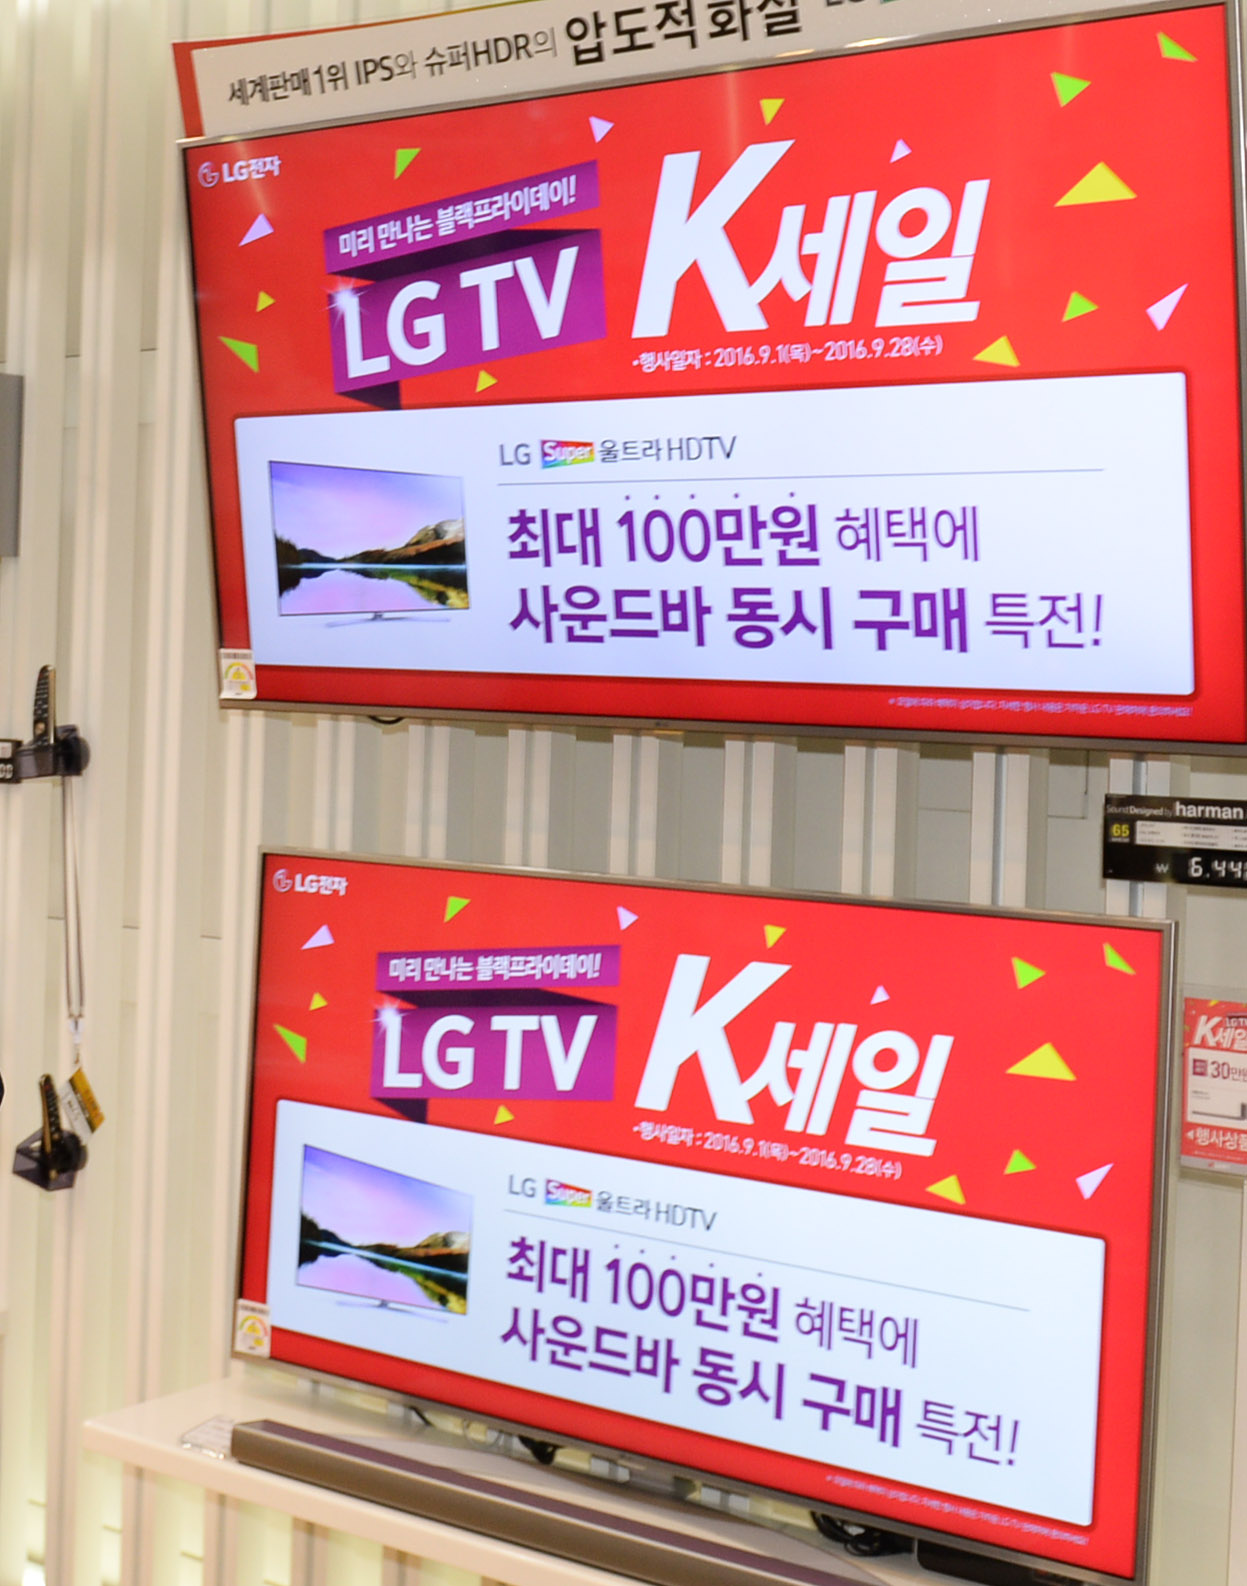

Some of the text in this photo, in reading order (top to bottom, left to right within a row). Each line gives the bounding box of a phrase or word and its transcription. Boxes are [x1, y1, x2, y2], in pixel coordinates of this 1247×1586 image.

[356, 50, 417, 85] IPS와
[424, 27, 557, 77] 슈퍼HDR의
[565, 0, 698, 66] 압도적
[222, 155, 281, 184] LG전자
[339, 174, 577, 257] 미리 만나는 블랙프라이데이!
[341, 246, 579, 379] LG TV
[499, 443, 532, 466] LG
[542, 440, 593, 464] Super
[508, 504, 979, 567] 최대 100만원 혜택에
[509, 585, 1103, 653] 사운드바 동시 구매 특전!
[1111, 824, 1130, 837] 65
[1175, 801, 1244, 819] harman
[294, 873, 349, 896] LG전자
[389, 957, 422, 982] 미리
[424, 956, 474, 982] 만나는
[382, 1014, 598, 1091] LG TV
[508, 1175, 536, 1198] LG
[507, 1236, 918, 1368] 최대 100만원 혜택에
[501, 1307, 1020, 1466] 사운드바 동시 구매 특전!
